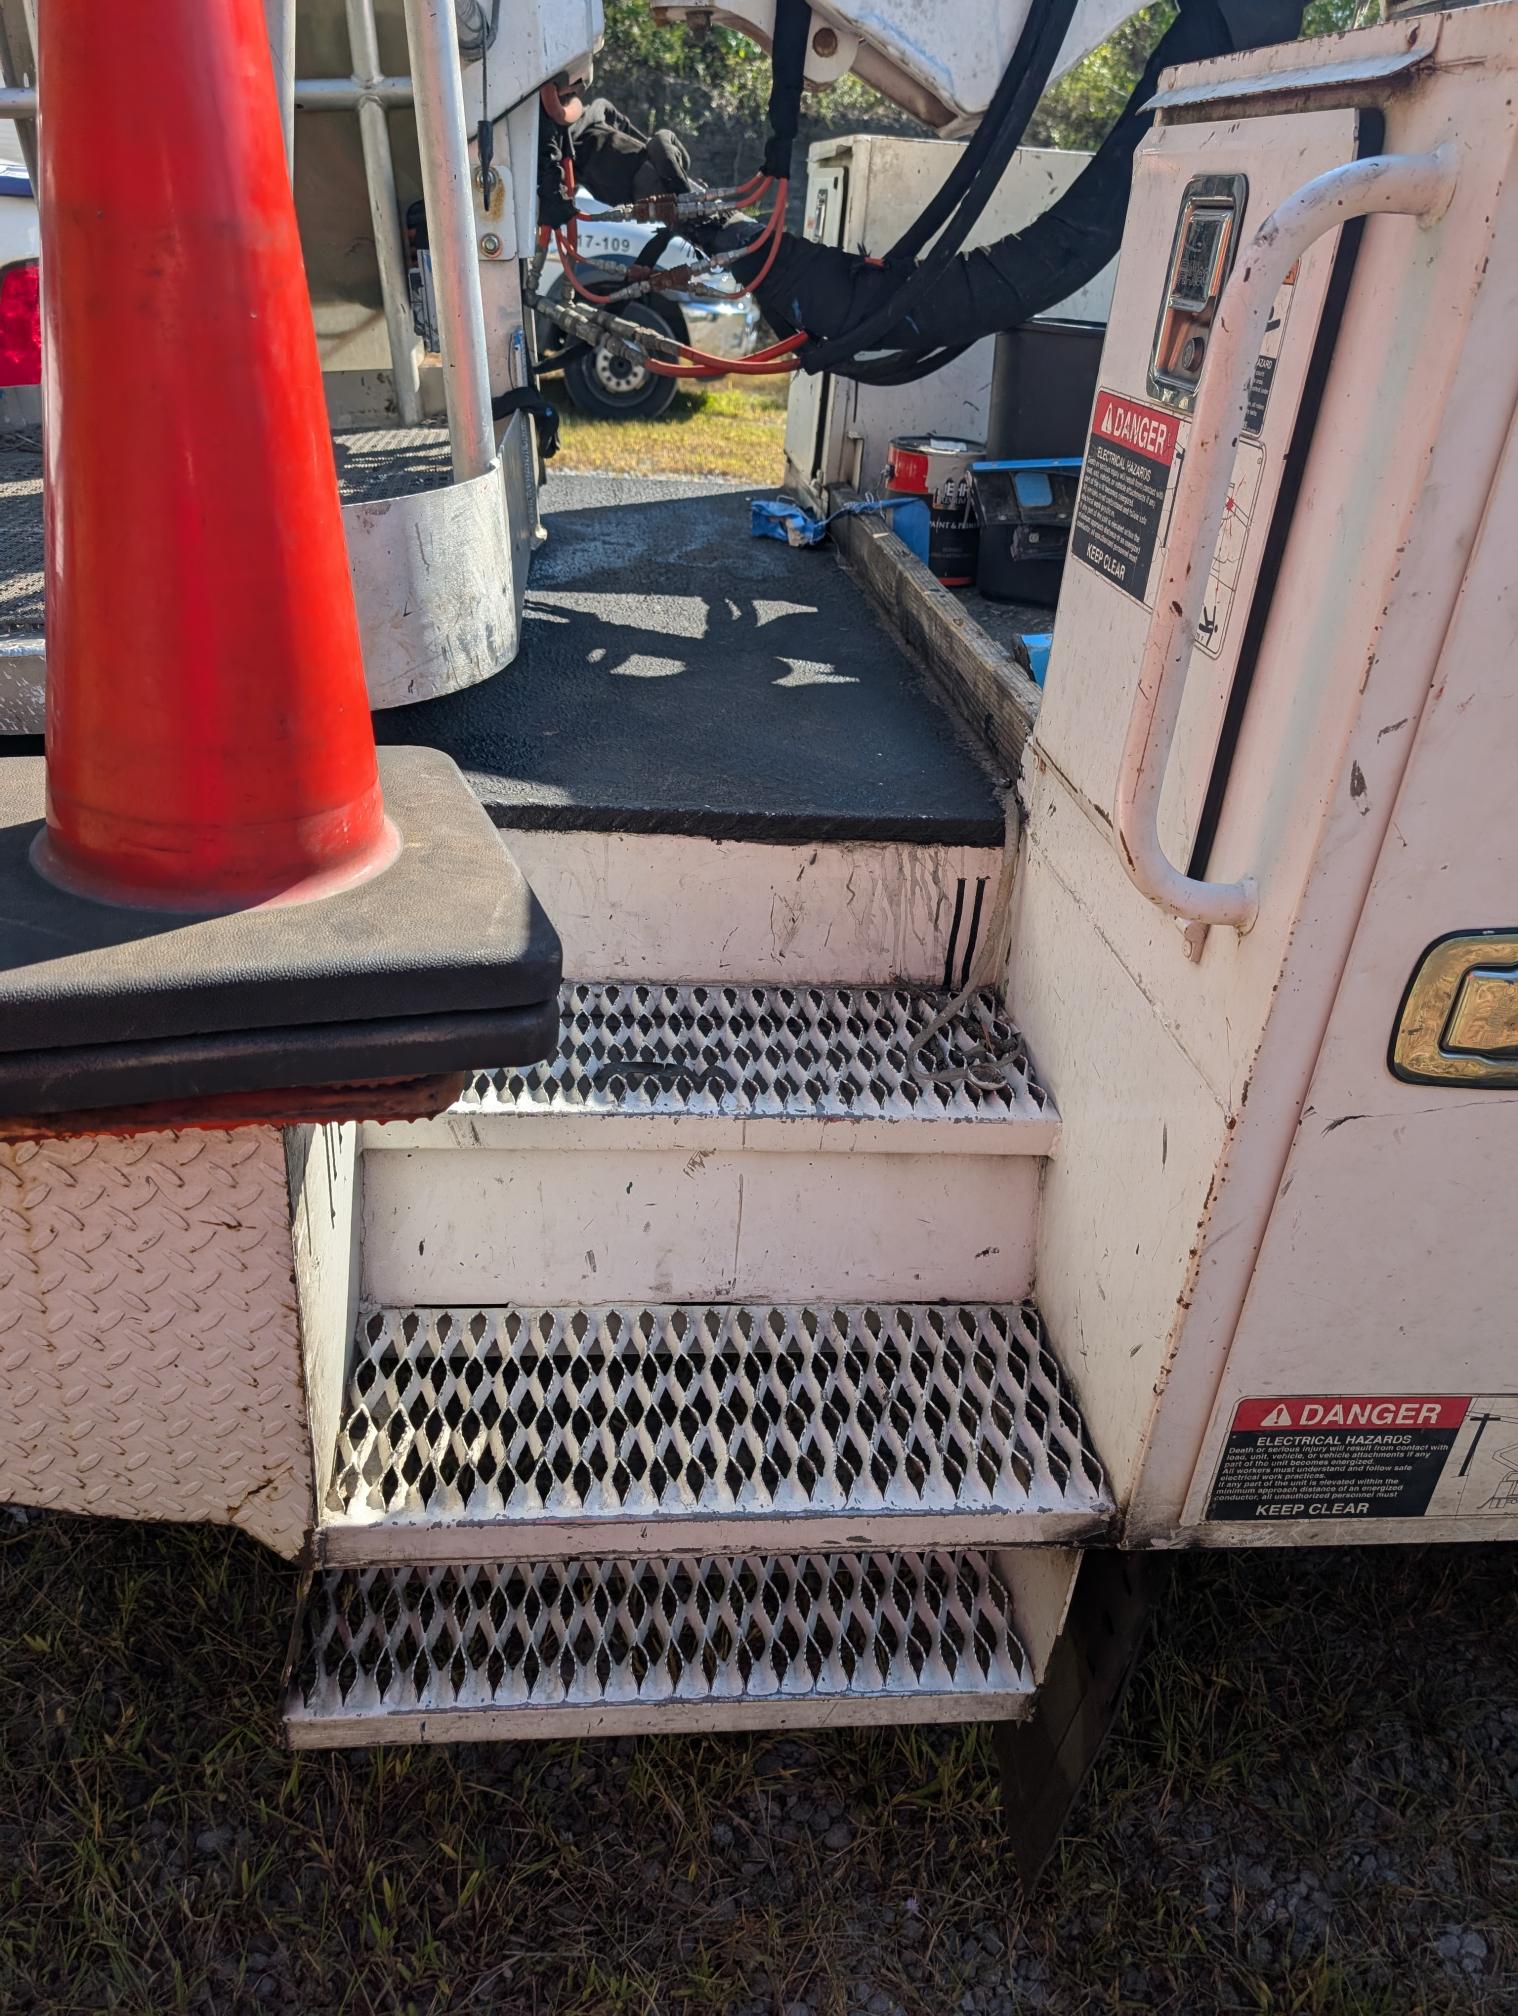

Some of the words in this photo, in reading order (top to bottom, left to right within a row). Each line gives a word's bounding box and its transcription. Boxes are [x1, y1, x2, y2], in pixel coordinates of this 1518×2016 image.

[1257, 358, 1272, 370] AZARD
[1113, 407, 1167, 457] DANGER
[1096, 446, 1126, 471] ELECTRICAL
[1126, 459, 1152, 482] HAZARDS
[930, 520, 950, 529] AINT
[1086, 542, 1104, 565] KEEP
[1103, 553, 1126, 581] CLEAR
[1299, 1403, 1442, 1426] DANGER
[1256, 1435, 1341, 1446] ELECTRICAL
[1345, 1435, 1412, 1445] HAZARDS
[1302, 1445, 1327, 1453] injury
[1396, 1443, 1429, 1451] contact
[1255, 1503, 1304, 1516] KEEP
[1308, 1502, 1370, 1515] CLEAR
